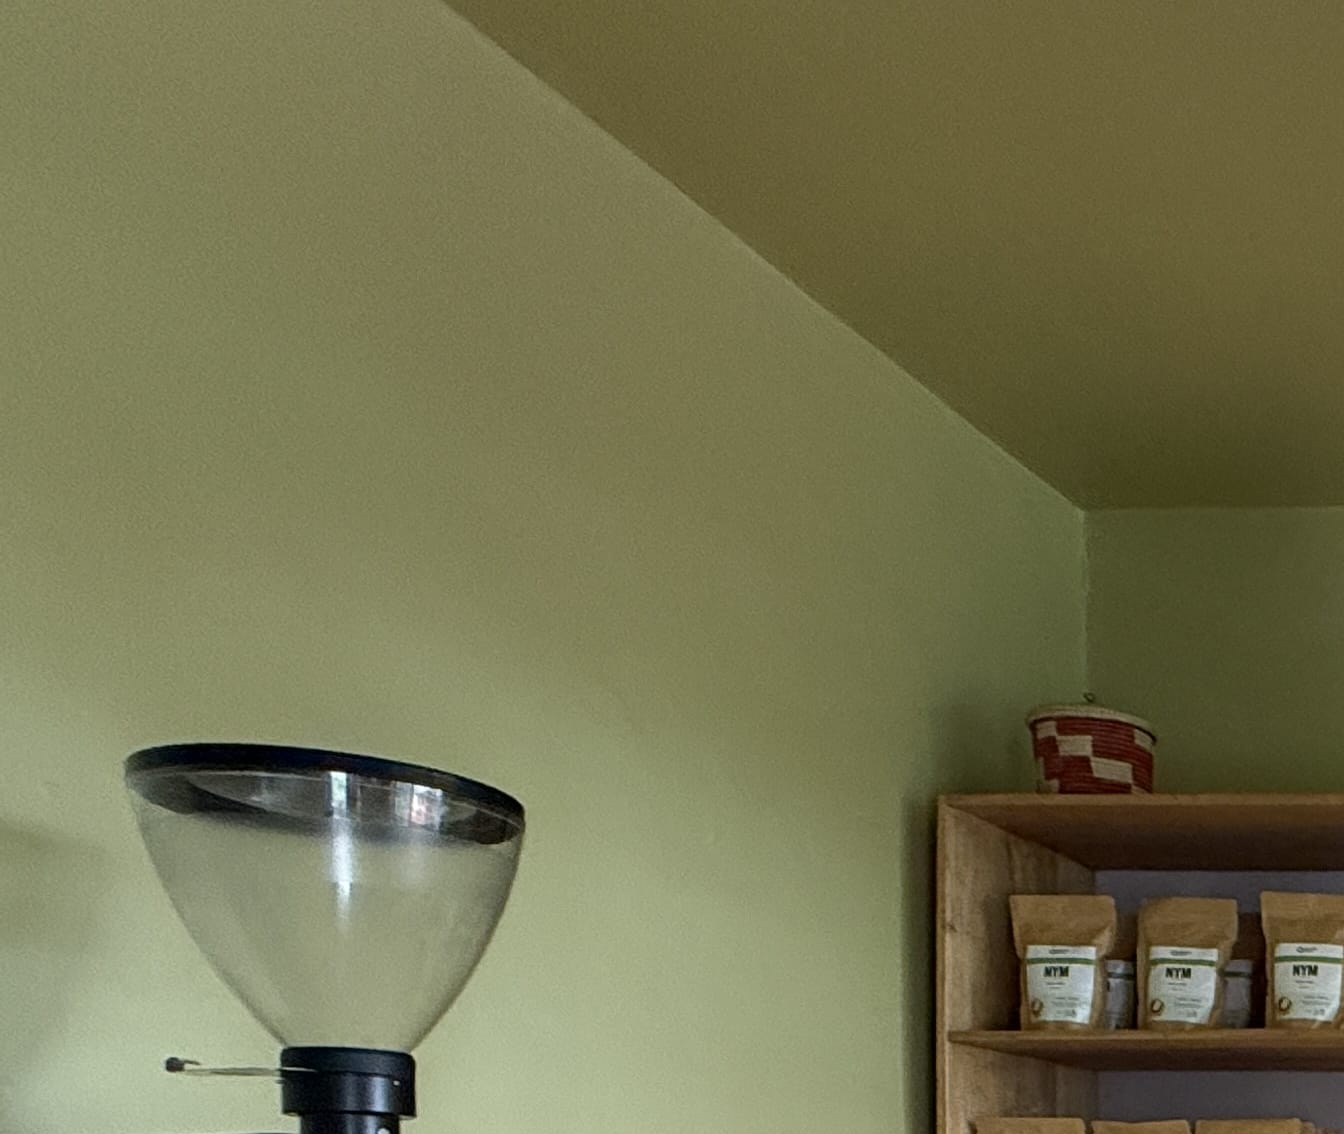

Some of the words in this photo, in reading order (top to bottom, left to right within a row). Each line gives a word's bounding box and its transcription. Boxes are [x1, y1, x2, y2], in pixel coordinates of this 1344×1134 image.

[1043, 966, 1069, 979] NYM
[1165, 967, 1192, 980] NYM
[1292, 964, 1319, 977] NYM
